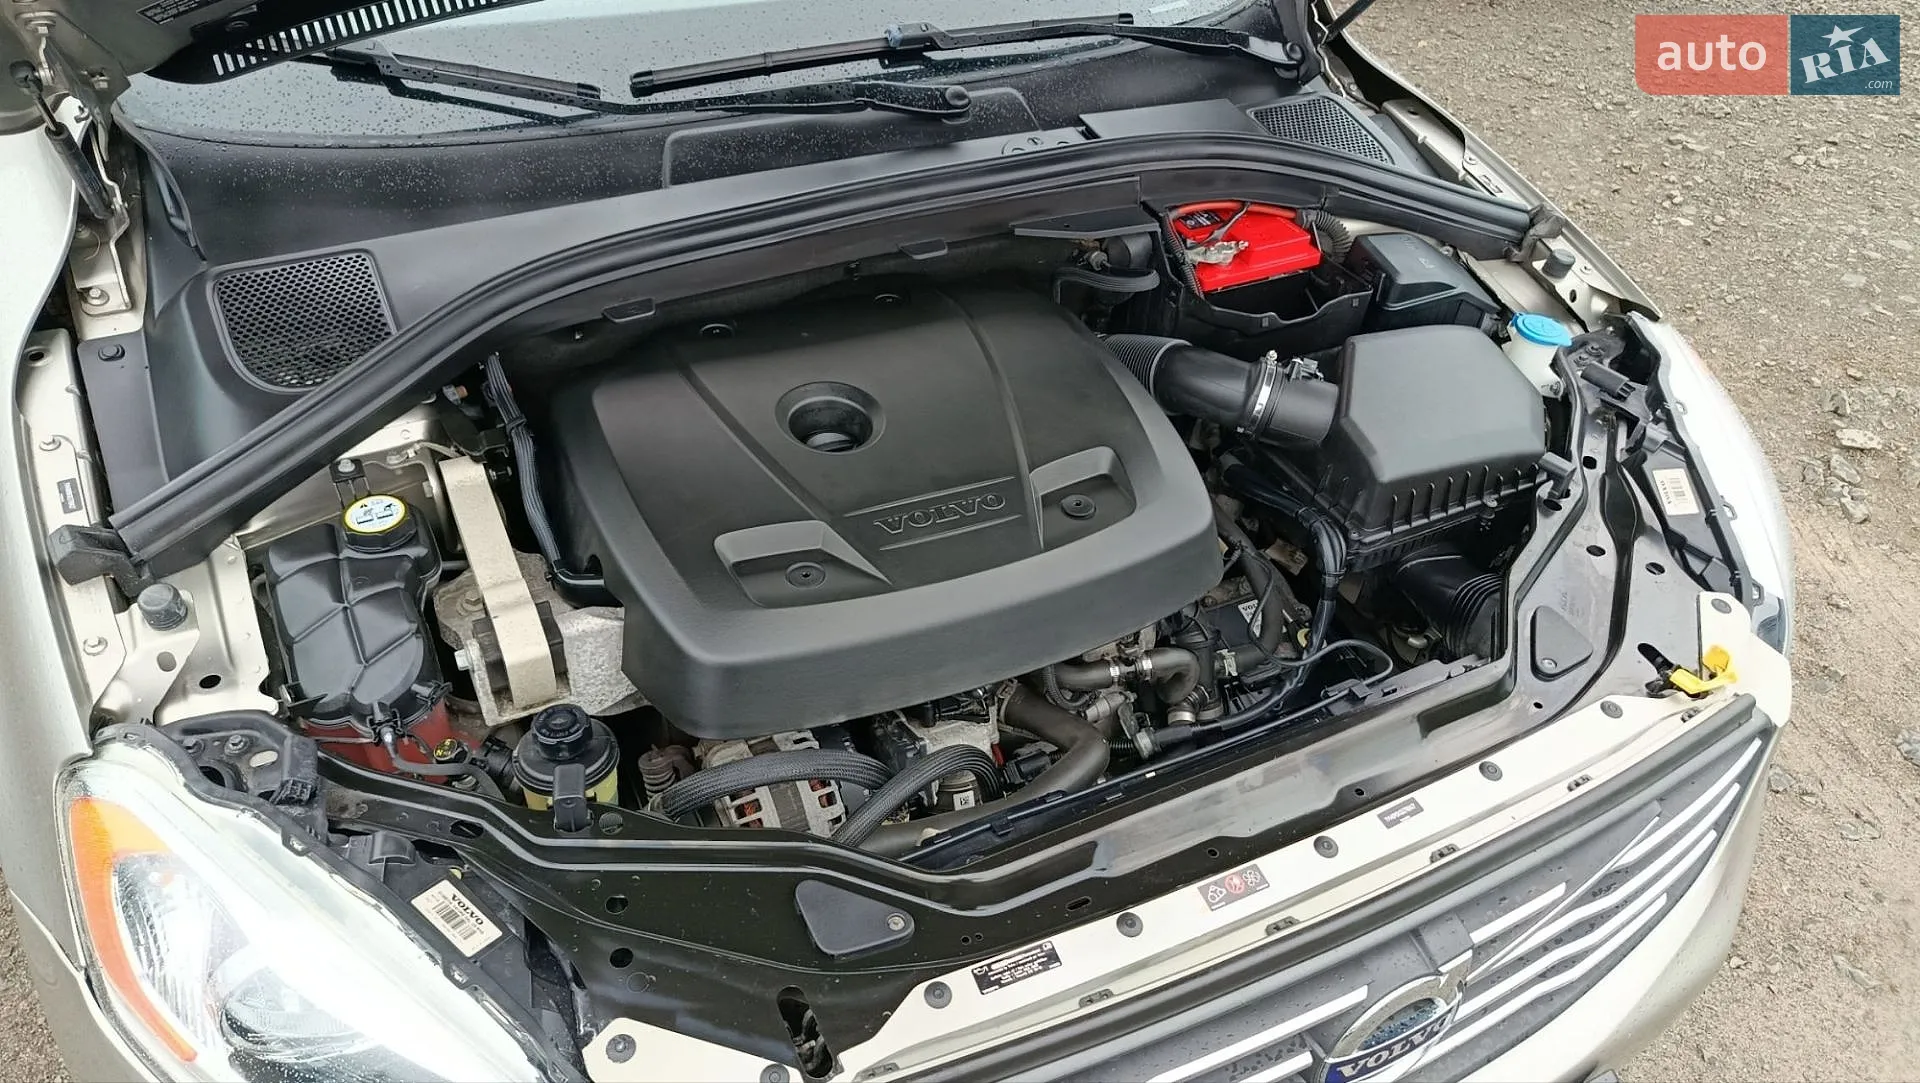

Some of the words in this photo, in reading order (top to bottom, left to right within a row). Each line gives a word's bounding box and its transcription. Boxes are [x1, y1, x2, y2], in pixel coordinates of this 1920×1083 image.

[872, 492, 1006, 535] VOLVO
[451, 893, 484, 926] VOLVO
[1336, 1013, 1449, 1078] VOLVO
